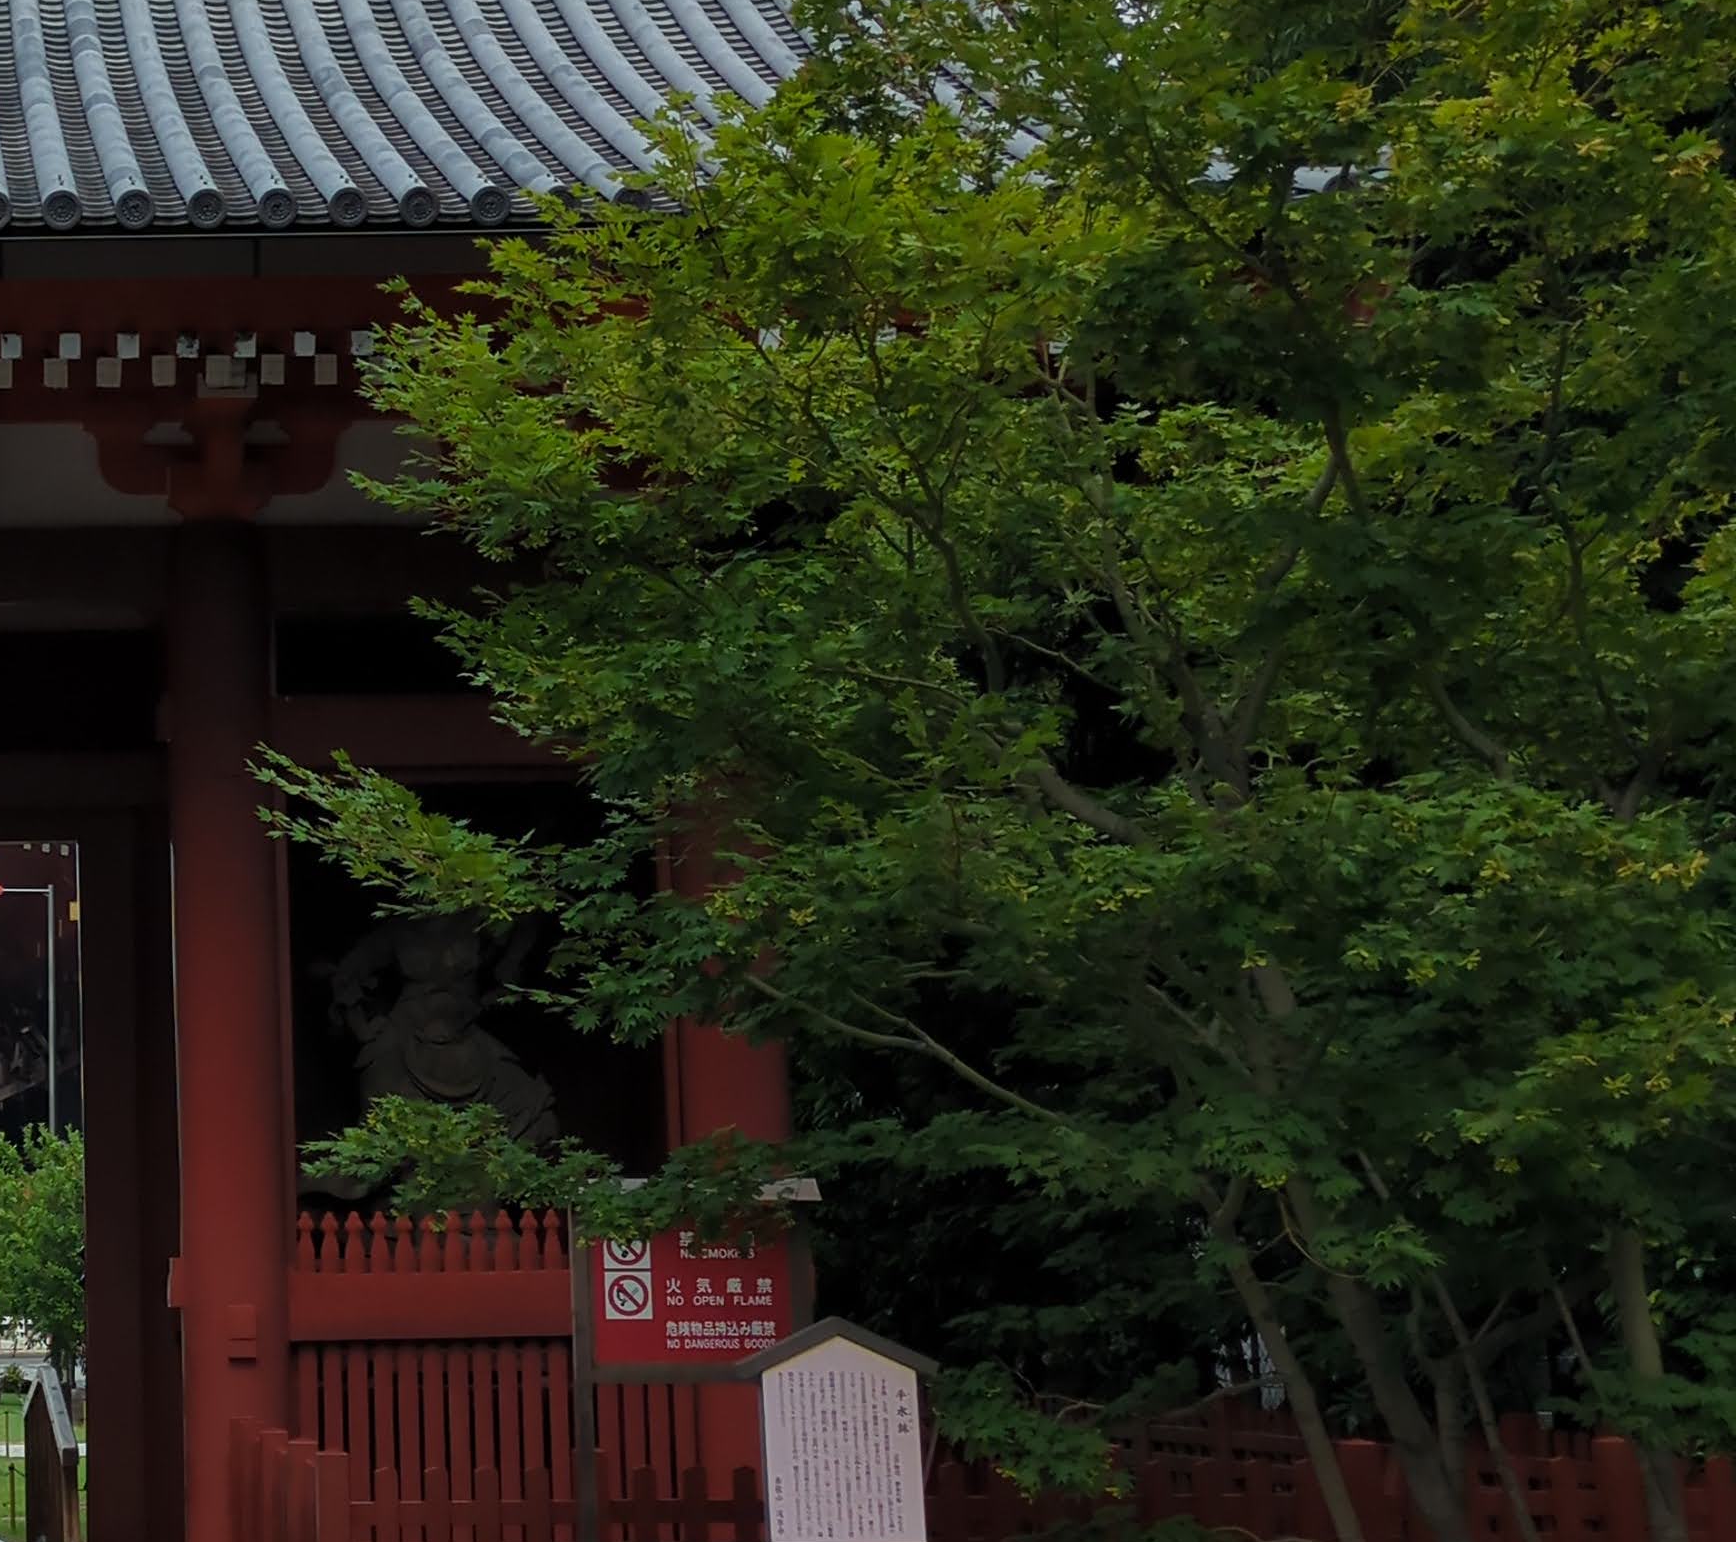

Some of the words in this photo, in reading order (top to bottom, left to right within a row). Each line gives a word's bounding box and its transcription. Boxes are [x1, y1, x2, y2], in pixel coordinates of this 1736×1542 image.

[666, 1295, 684, 1306] NO
[693, 1295, 725, 1306] OPEN
[733, 1295, 773, 1306] FLAME
[666, 1338, 681, 1349] NO
[684, 1338, 740, 1349] DANGEROUS
